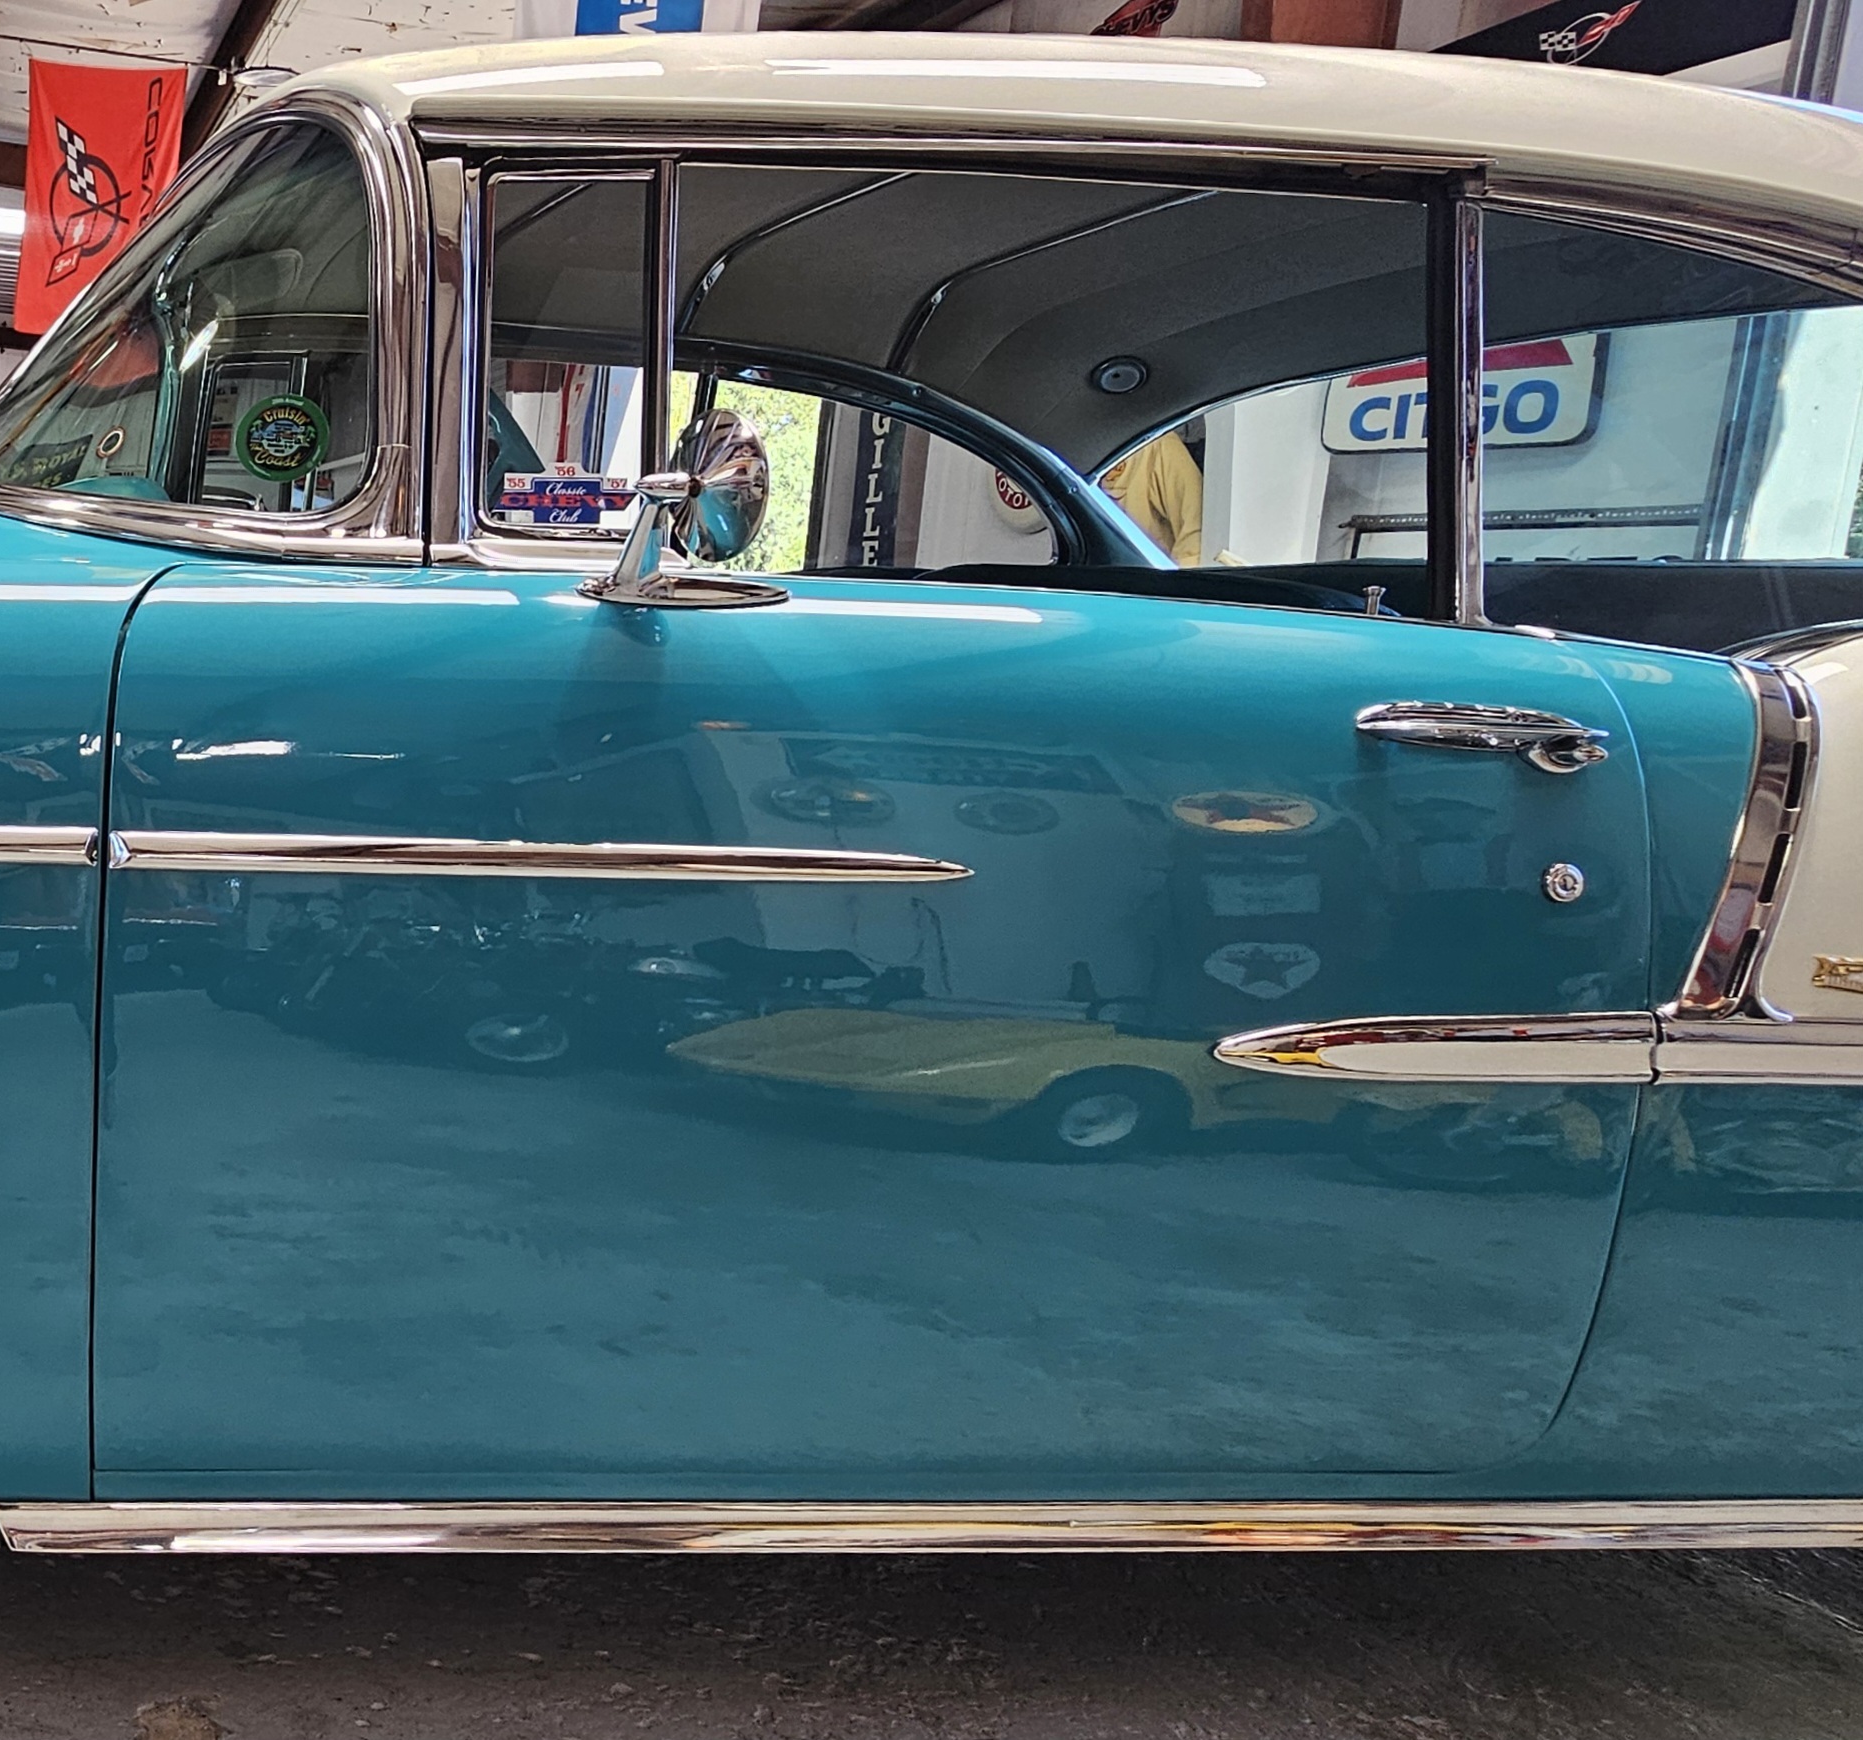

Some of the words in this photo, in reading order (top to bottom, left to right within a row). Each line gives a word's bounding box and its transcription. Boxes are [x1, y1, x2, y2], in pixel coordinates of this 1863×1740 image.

[254, 450, 302, 467] Coast
[554, 465, 577, 477] '56
[506, 477, 526, 489] '55
[607, 477, 629, 489] '57
[545, 481, 588, 497] Classic
[499, 494, 637, 508] CHEVY
[548, 508, 583, 524] Club
